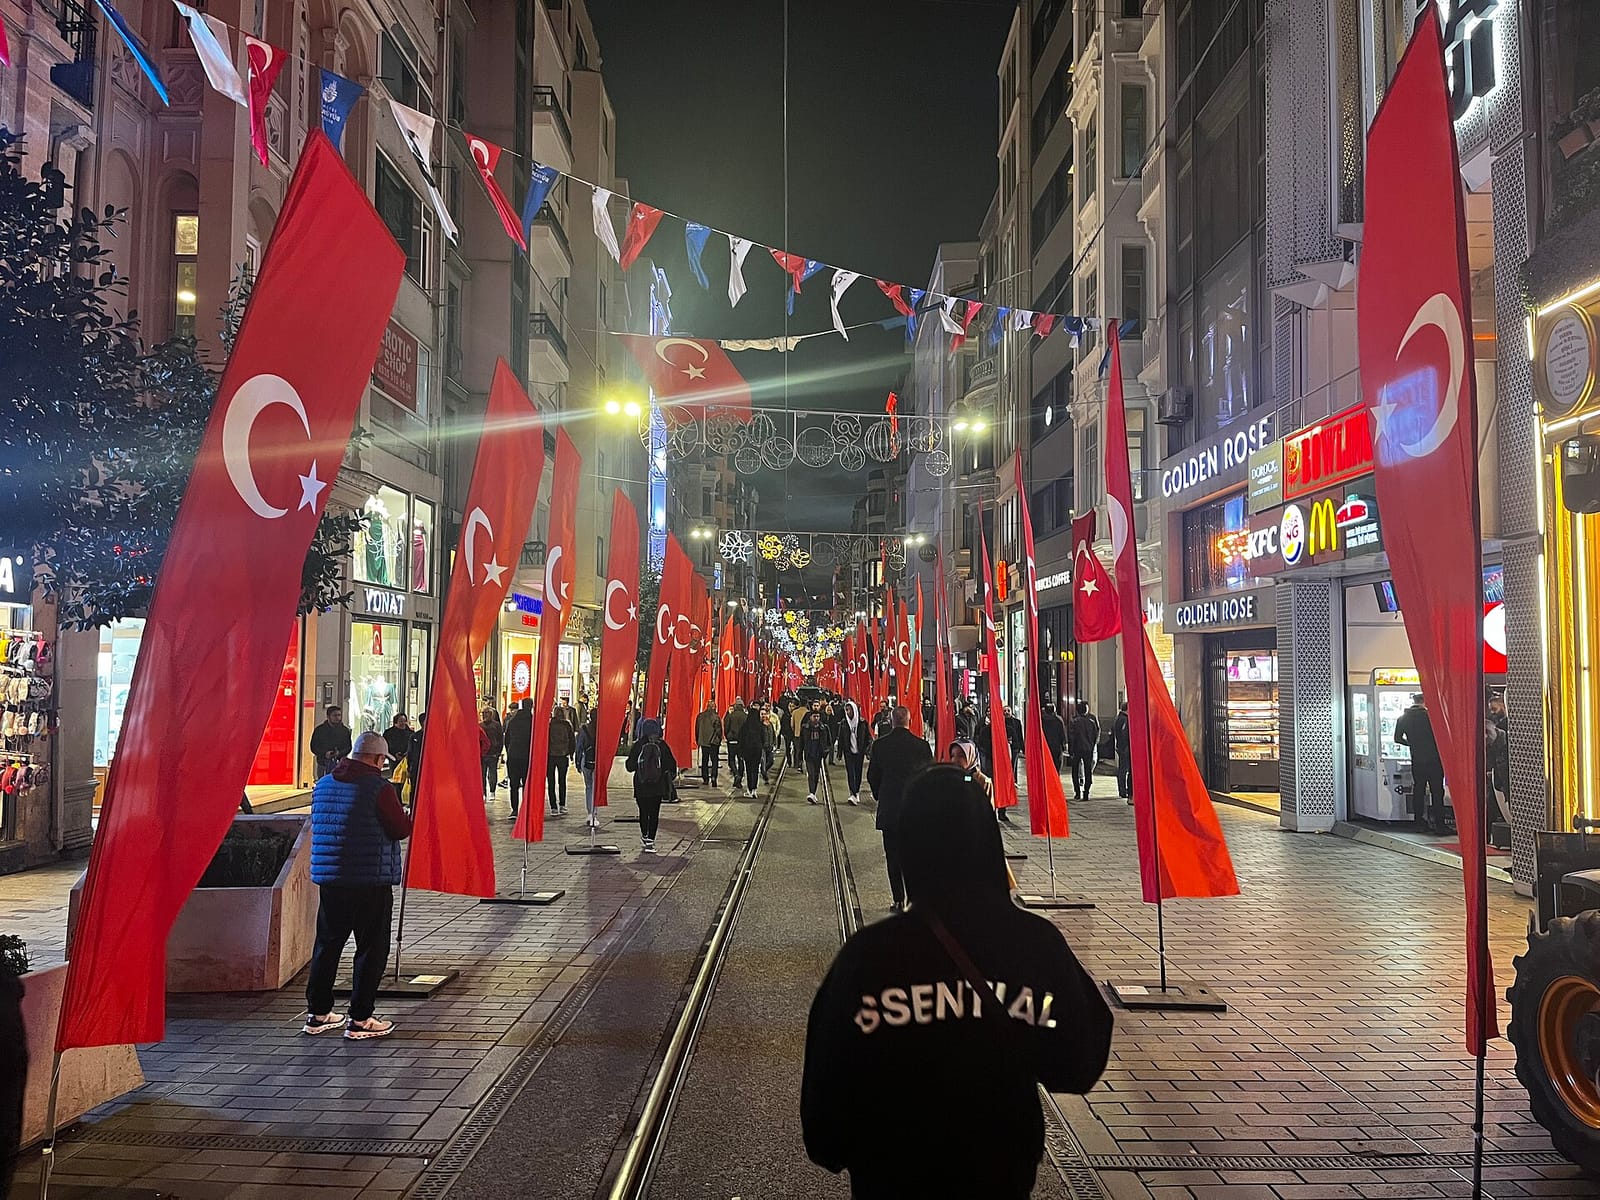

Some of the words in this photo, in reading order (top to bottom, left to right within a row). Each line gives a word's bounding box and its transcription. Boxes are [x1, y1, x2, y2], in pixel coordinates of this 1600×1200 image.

[382, 327, 412, 363] ROTIC
[384, 349, 407, 376] SHOP
[1162, 445, 1218, 497] GOLDEN
[1224, 418, 1269, 470] ROSE
[1247, 525, 1277, 559] KFC
[1052, 570, 1071, 588] COFFEE
[364, 588, 405, 615] YONAT
[1176, 602, 1218, 626] GOLDEN
[1222, 595, 1254, 621] ROSE
